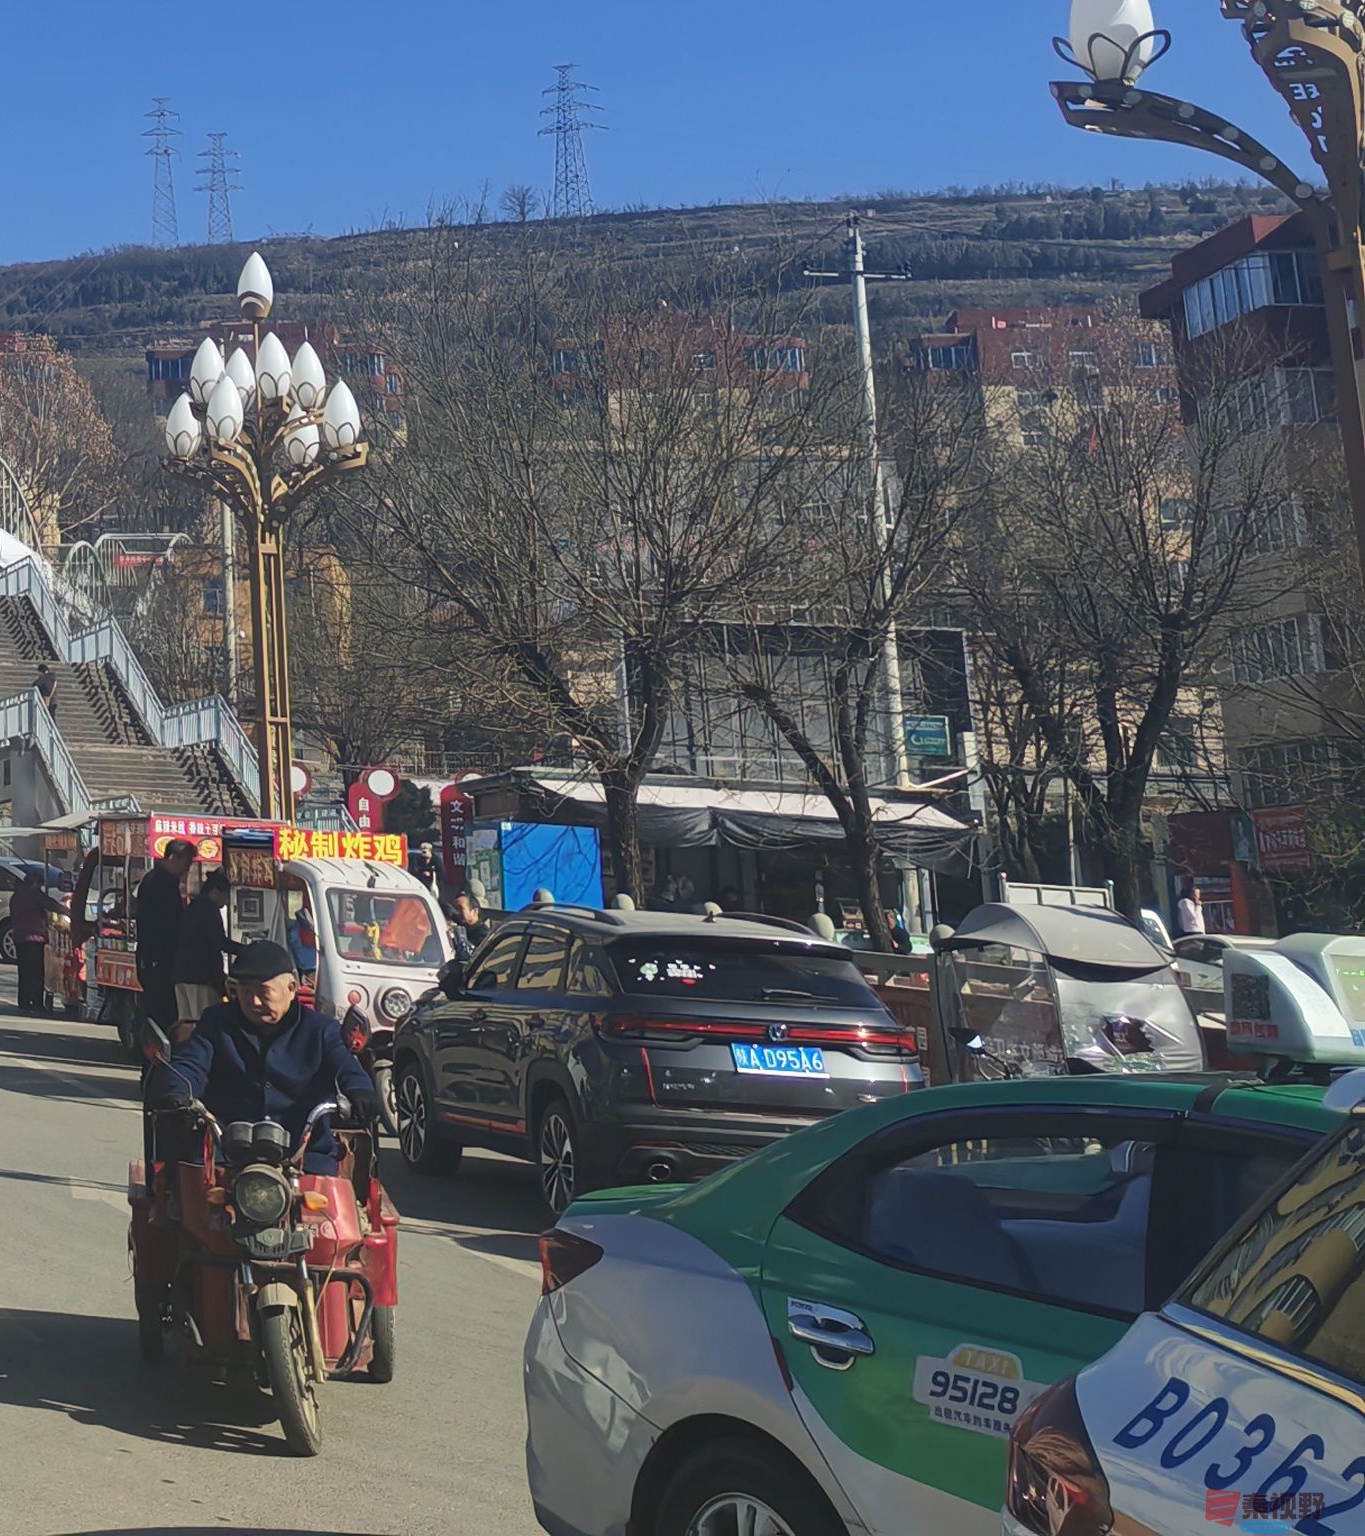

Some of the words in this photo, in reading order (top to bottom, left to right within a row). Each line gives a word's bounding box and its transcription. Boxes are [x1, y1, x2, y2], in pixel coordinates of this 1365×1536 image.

[279, 829, 402, 865] 秘制炸鸡
[929, 1370, 1021, 1416] 95128
